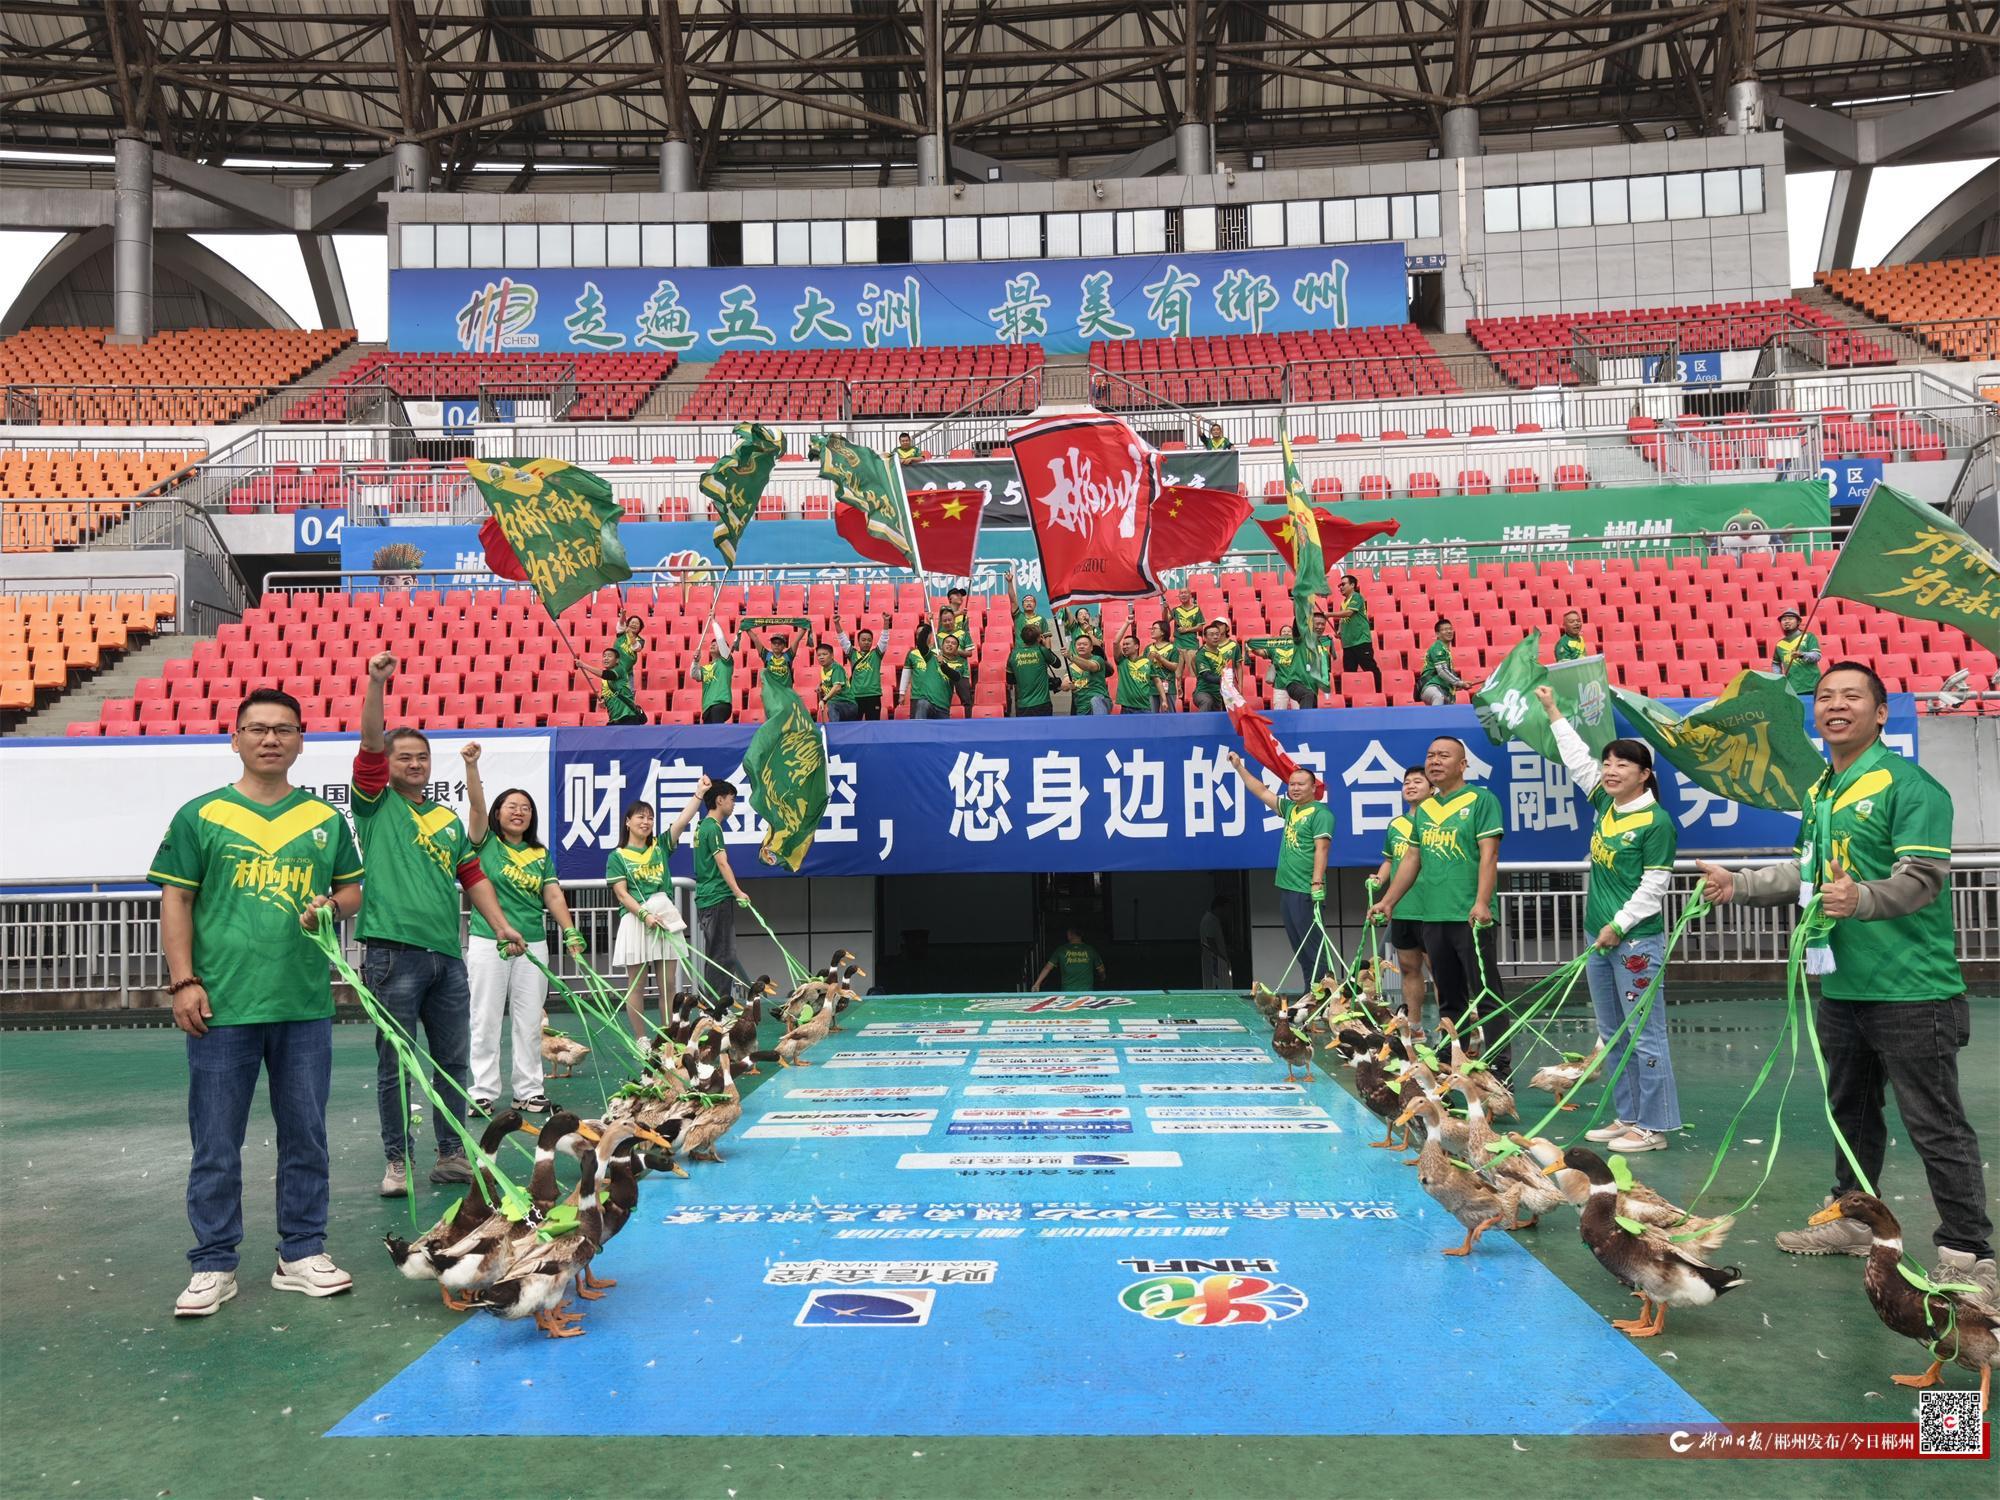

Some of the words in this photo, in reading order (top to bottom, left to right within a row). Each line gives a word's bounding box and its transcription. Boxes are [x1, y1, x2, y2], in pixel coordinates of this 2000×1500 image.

[565, 274, 922, 350] 走遍五大洲
[989, 260, 1349, 341] 最美有郴州
[502, 336, 537, 345] CHEN
[1695, 360, 1707, 372] 区
[1695, 374, 1718, 382] Area
[1848, 468, 1864, 483] 区
[1848, 486, 1870, 497] Are
[300, 516, 345, 546] 04
[231, 856, 314, 900] 郴州
[956, 1169, 1116, 1177] 冠名合作伙伴
[1120, 1259, 1274, 1274] HNFL
[769, 1267, 988, 1284] 财信金控
